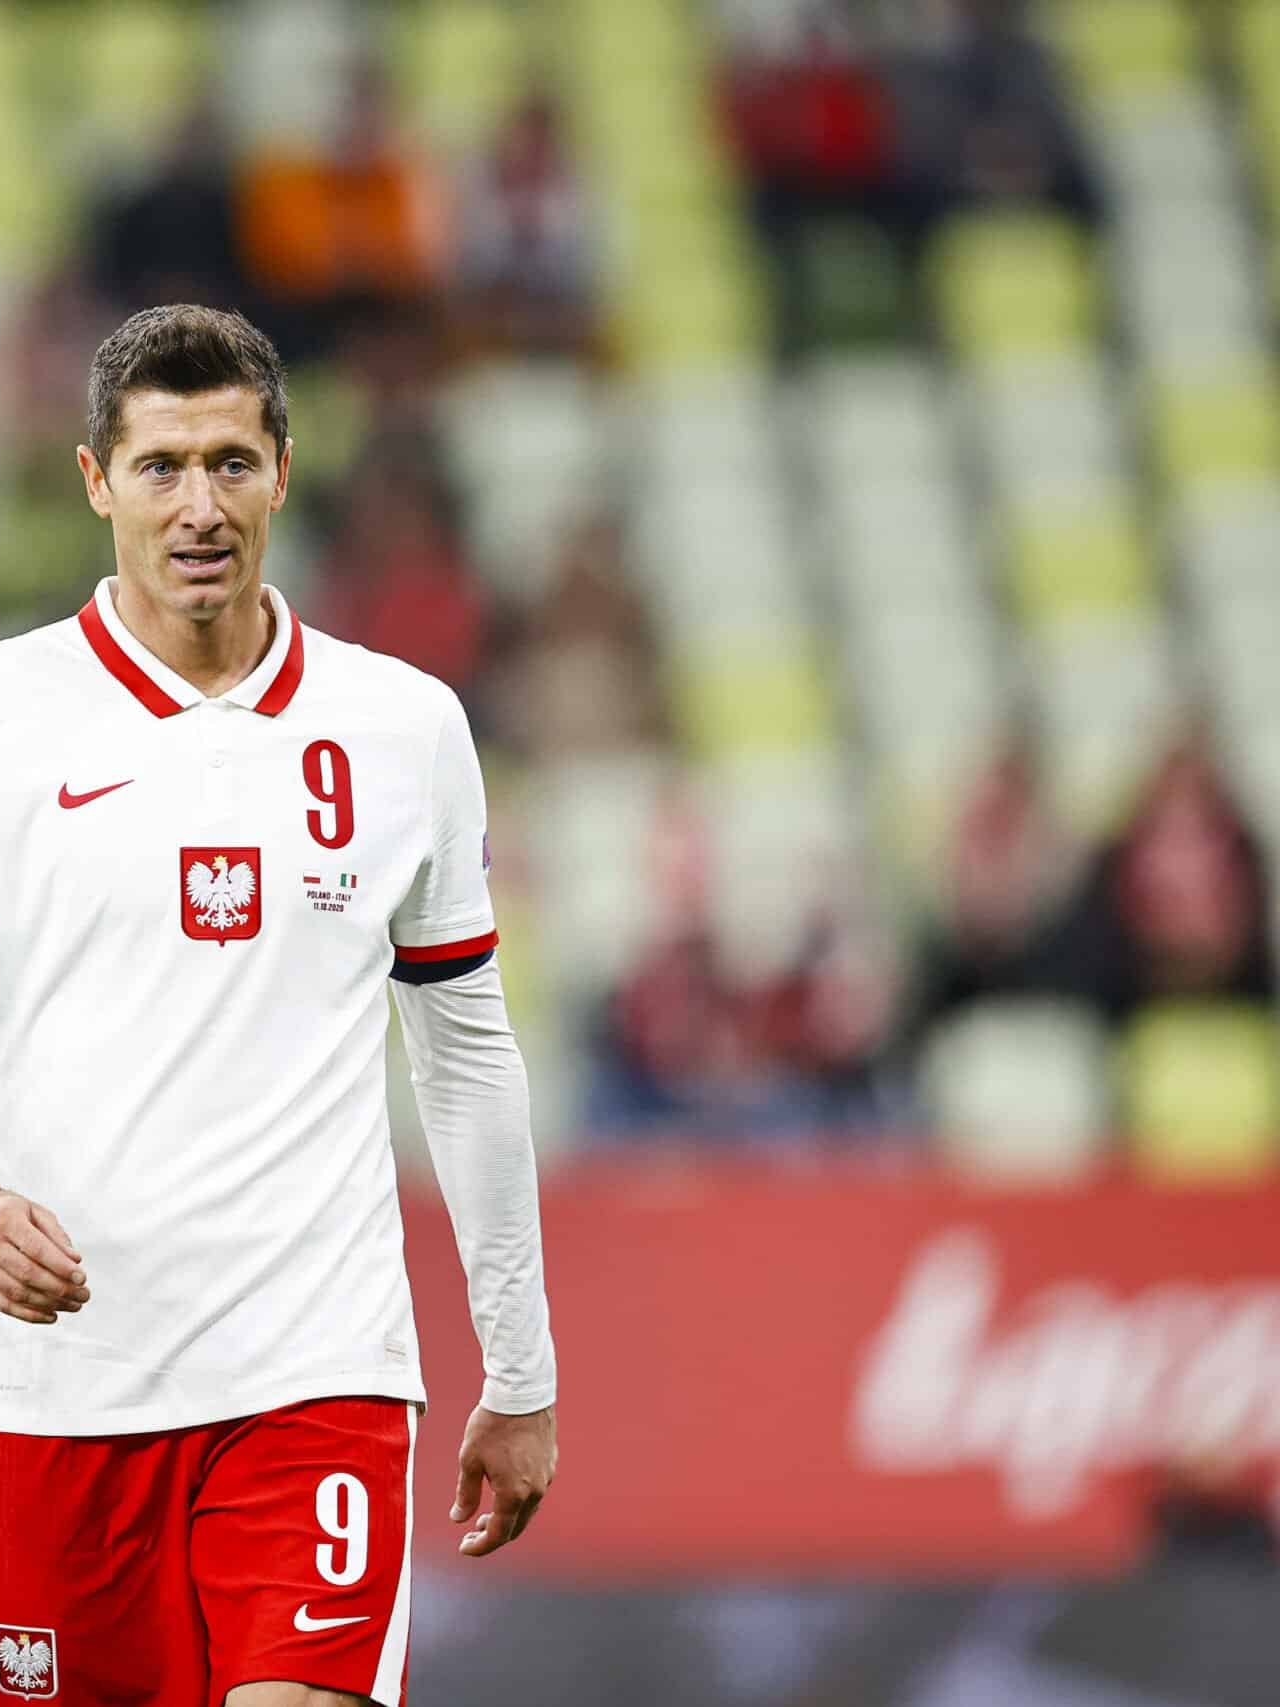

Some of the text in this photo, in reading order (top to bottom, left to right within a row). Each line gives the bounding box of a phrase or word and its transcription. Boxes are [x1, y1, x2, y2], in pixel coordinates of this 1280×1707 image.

[302, 739, 354, 850] 9
[307, 890, 331, 900] POLAND
[335, 893, 352, 902] ITALY
[315, 1472, 369, 1586] 9
